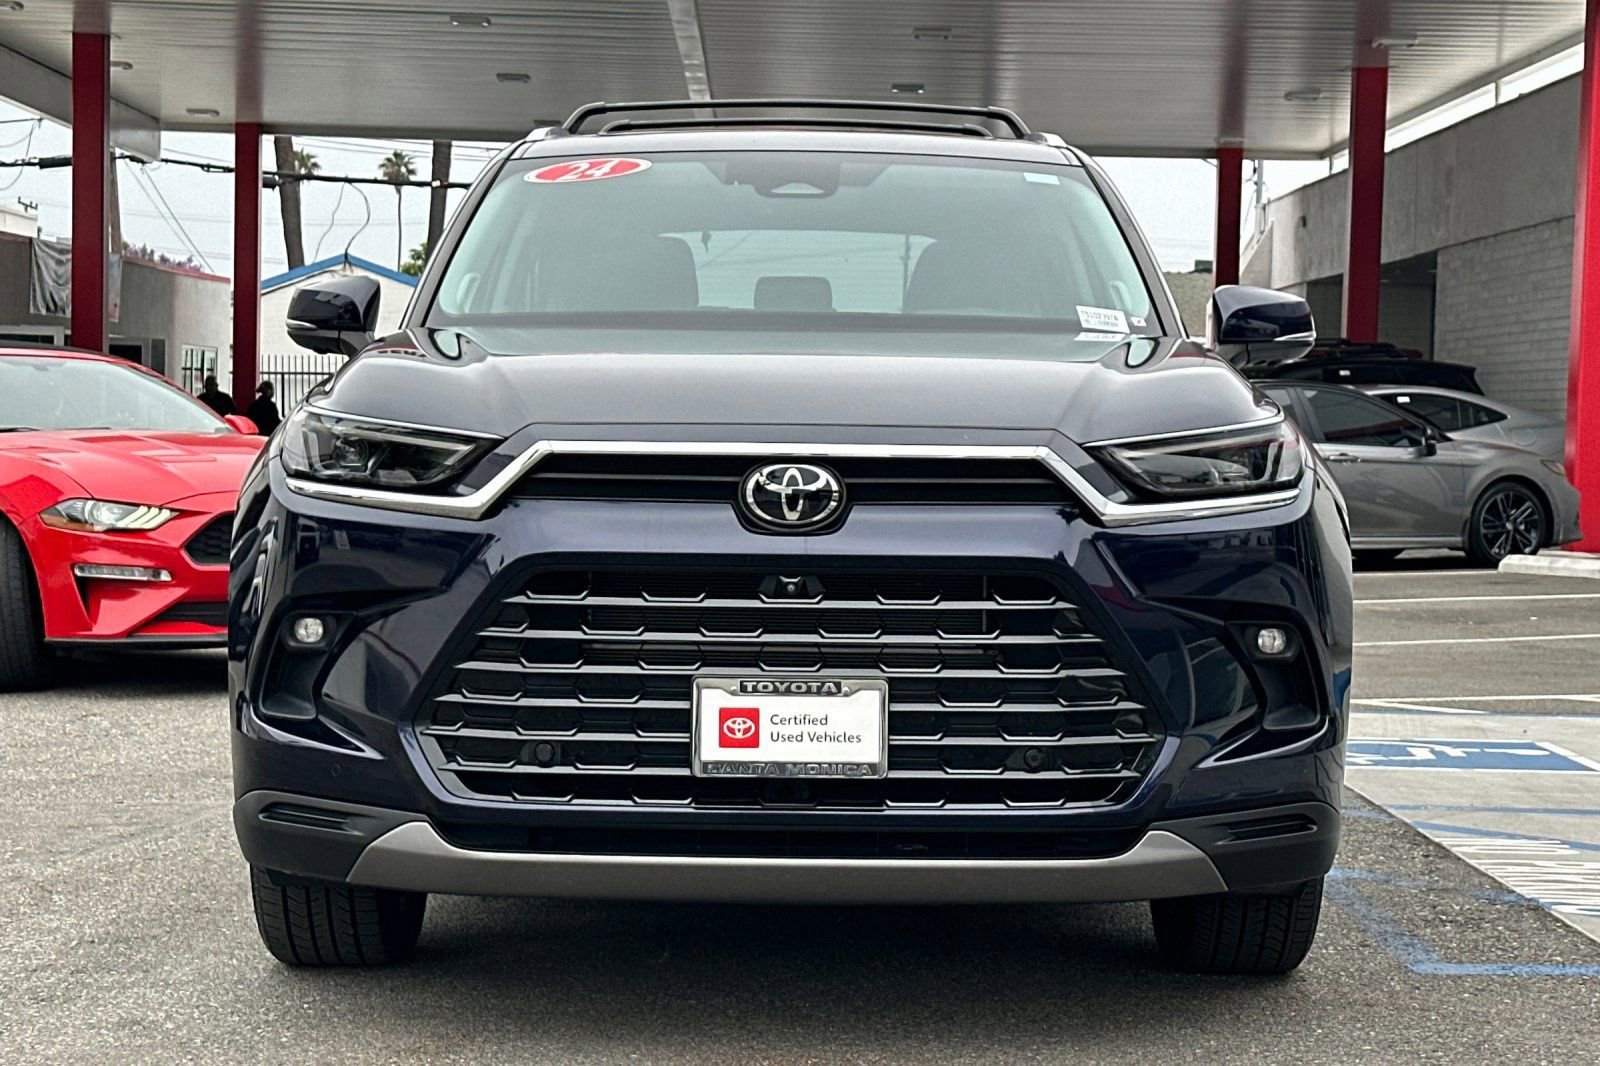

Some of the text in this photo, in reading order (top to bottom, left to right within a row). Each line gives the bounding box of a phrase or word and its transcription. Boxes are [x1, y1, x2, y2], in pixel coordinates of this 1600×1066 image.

[556, 159, 620, 181] 24
[743, 682, 838, 693] TOYOTA
[770, 714, 828, 726] Certified
[770, 731, 862, 743] Used Vehicles
[707, 763, 872, 776] SANTA MONICA
